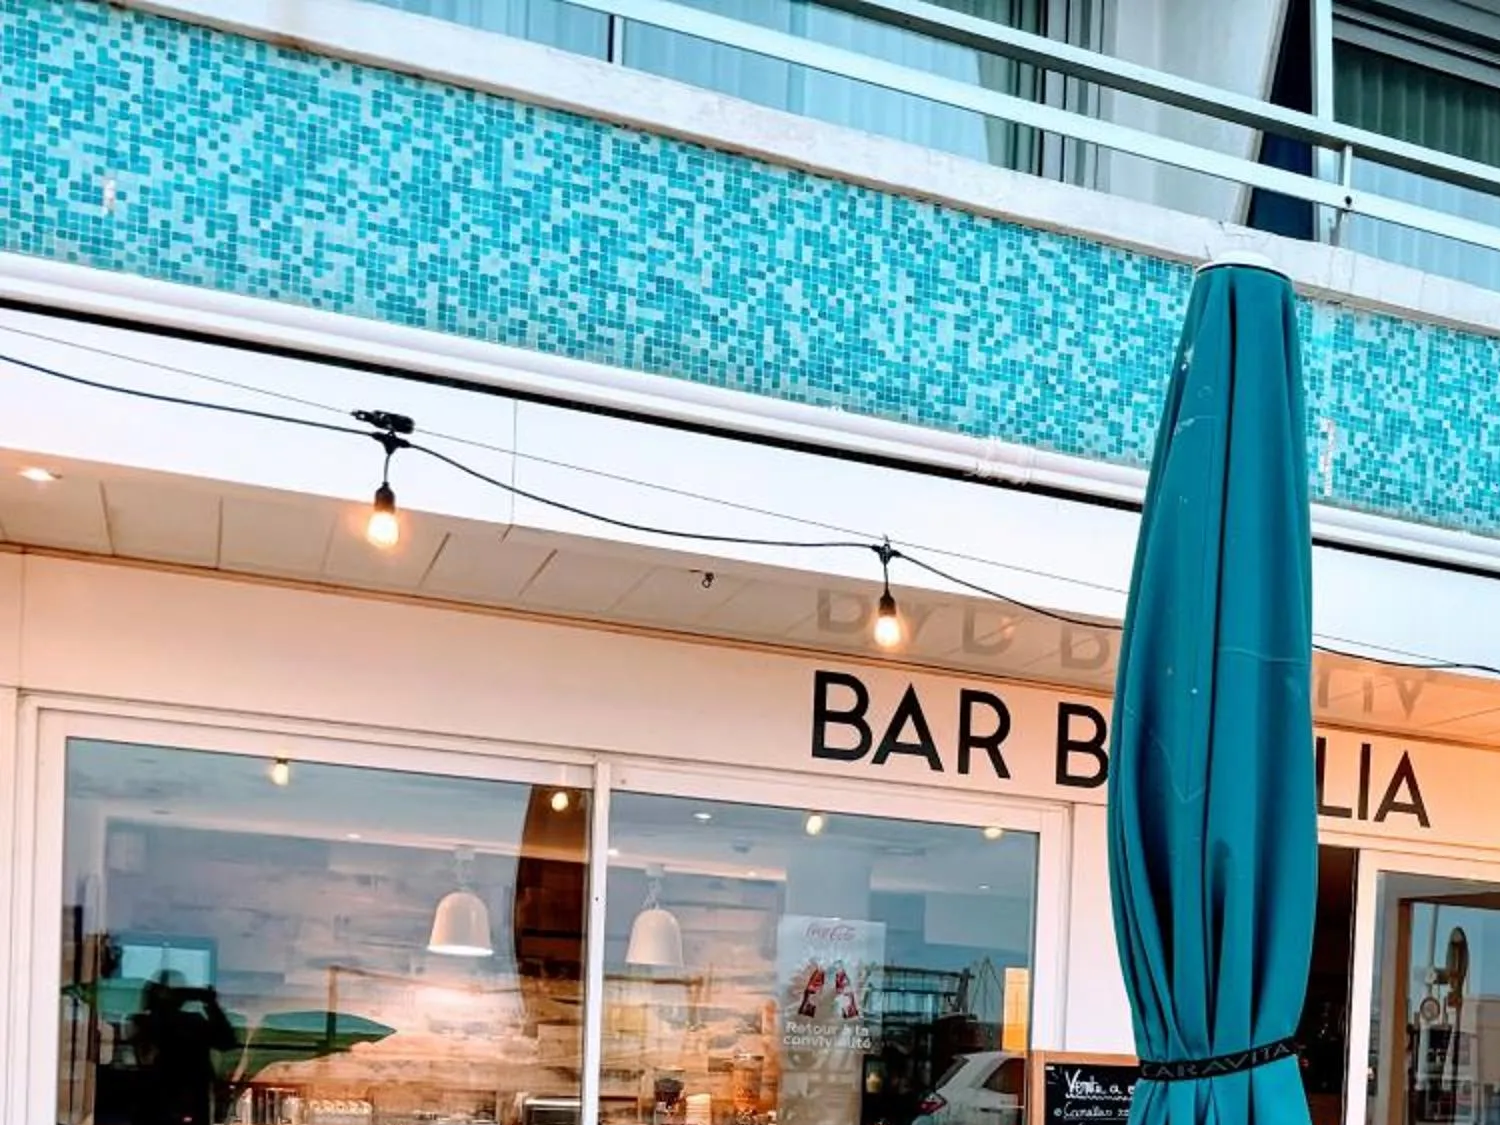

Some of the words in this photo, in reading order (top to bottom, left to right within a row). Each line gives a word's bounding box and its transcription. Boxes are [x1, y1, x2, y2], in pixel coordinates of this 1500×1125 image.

[811, 669, 1012, 780] BAR
[1055, 701, 1431, 829] BLIA
[783, 1035, 872, 1050] convivlité
